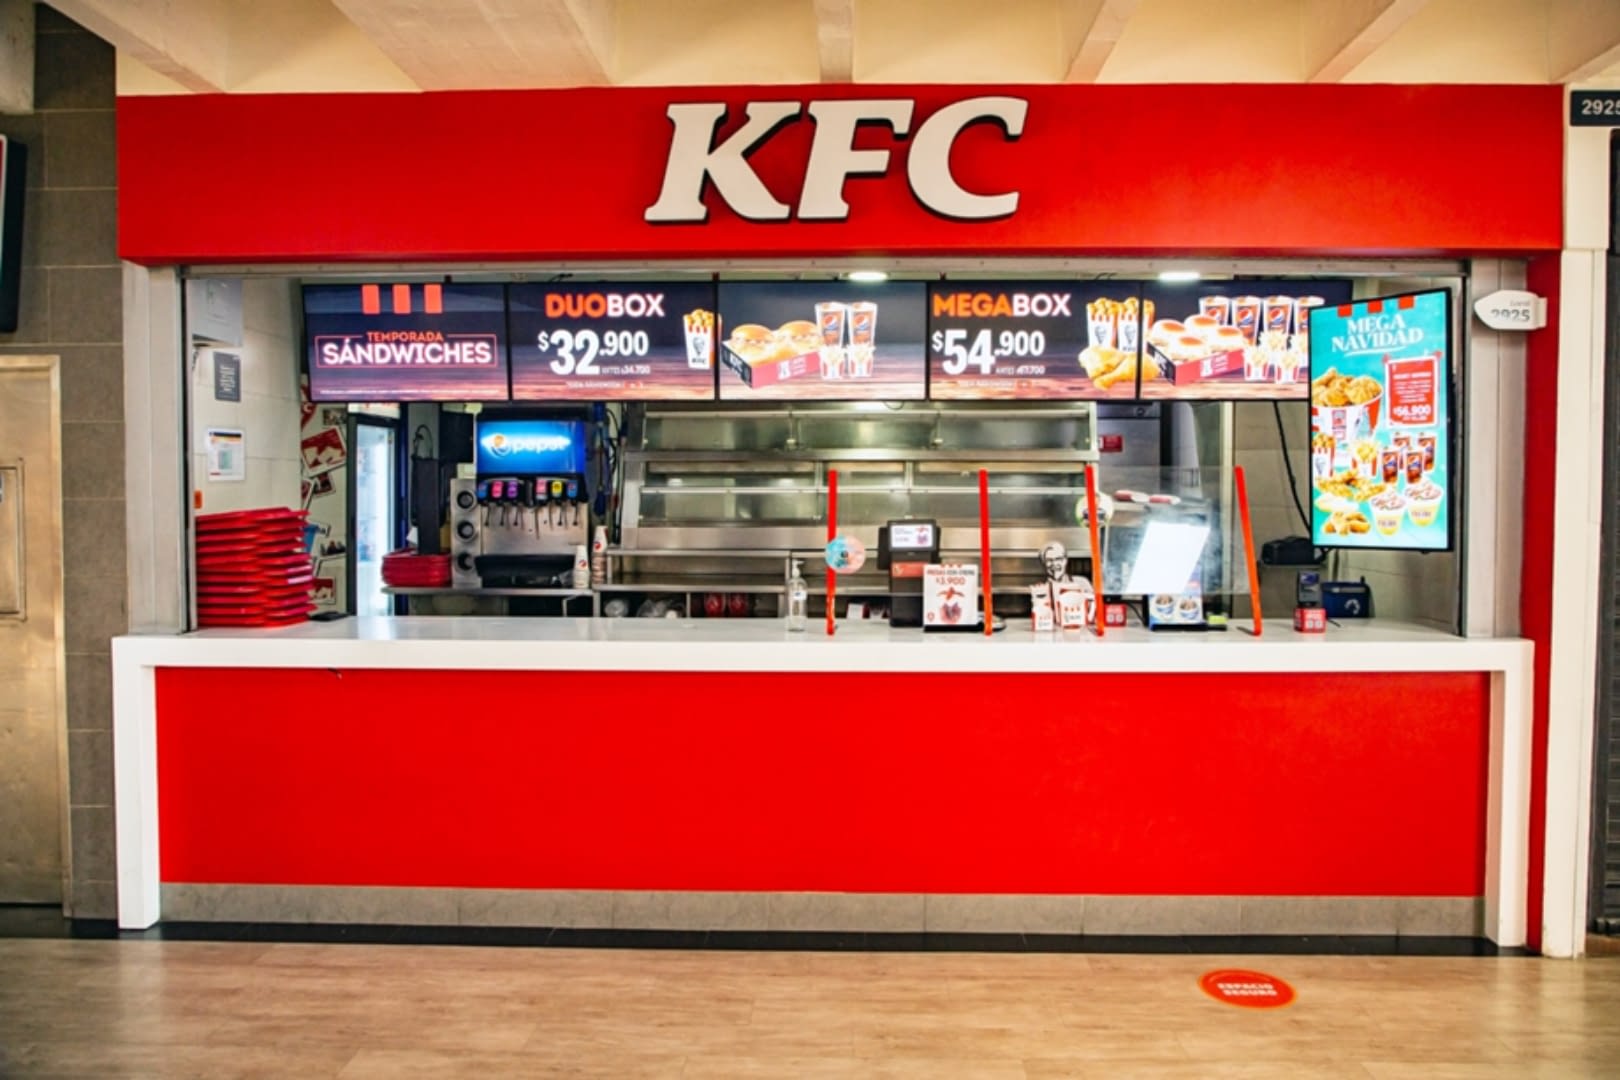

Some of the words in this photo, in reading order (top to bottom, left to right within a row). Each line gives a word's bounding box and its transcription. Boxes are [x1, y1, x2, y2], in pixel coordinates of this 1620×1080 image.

[644, 96, 1028, 221] KFC
[545, 292, 664, 318] DUOBOX
[933, 292, 1071, 318] MEGABOX
[366, 331, 443, 342] TEMPORADA
[1347, 313, 1406, 335] MEGA
[322, 338, 492, 365] SÁNDWICHES
[1331, 327, 1424, 353] NAVIDAD
